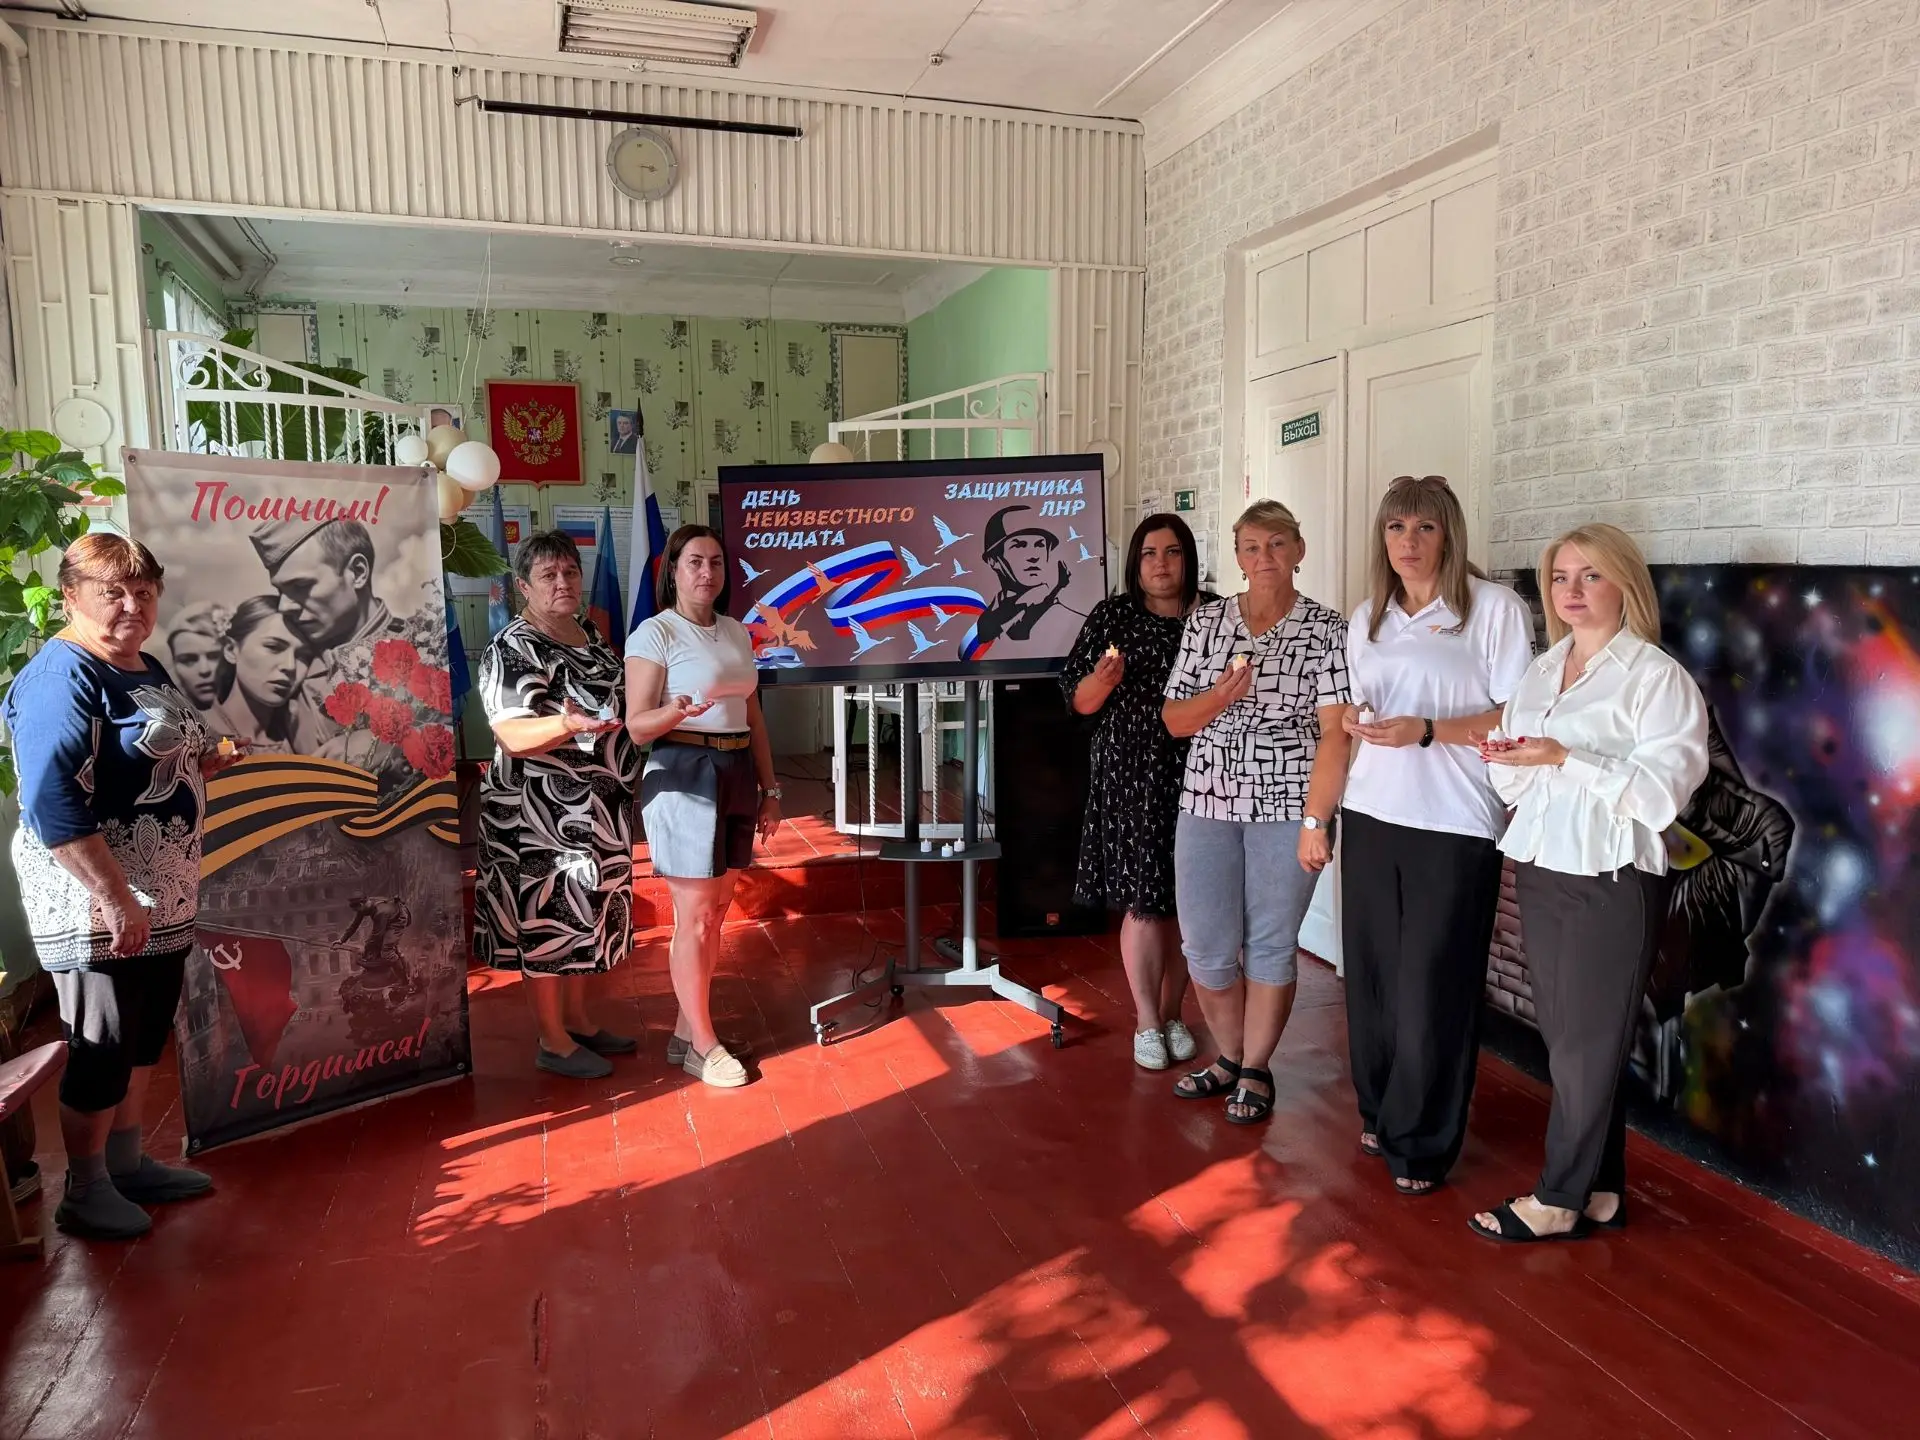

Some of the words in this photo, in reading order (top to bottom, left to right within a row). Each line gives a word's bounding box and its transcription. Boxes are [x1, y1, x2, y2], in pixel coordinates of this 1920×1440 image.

[1283, 422, 1317, 442] ВЫХОД
[1284, 415, 1316, 431] ЗАПАСНЫЙ
[741, 489, 801, 510] ДЕНЬ
[944, 477, 1084, 501] ЗАЩИТНИКА
[190, 481, 390, 525] Помним!
[1039, 499, 1086, 519] ЛНР
[743, 506, 914, 529] НЕИЗВЕСТНОГО
[744, 530, 846, 550] СОЛДАТА
[230, 1017, 431, 1110] Гордимся!
